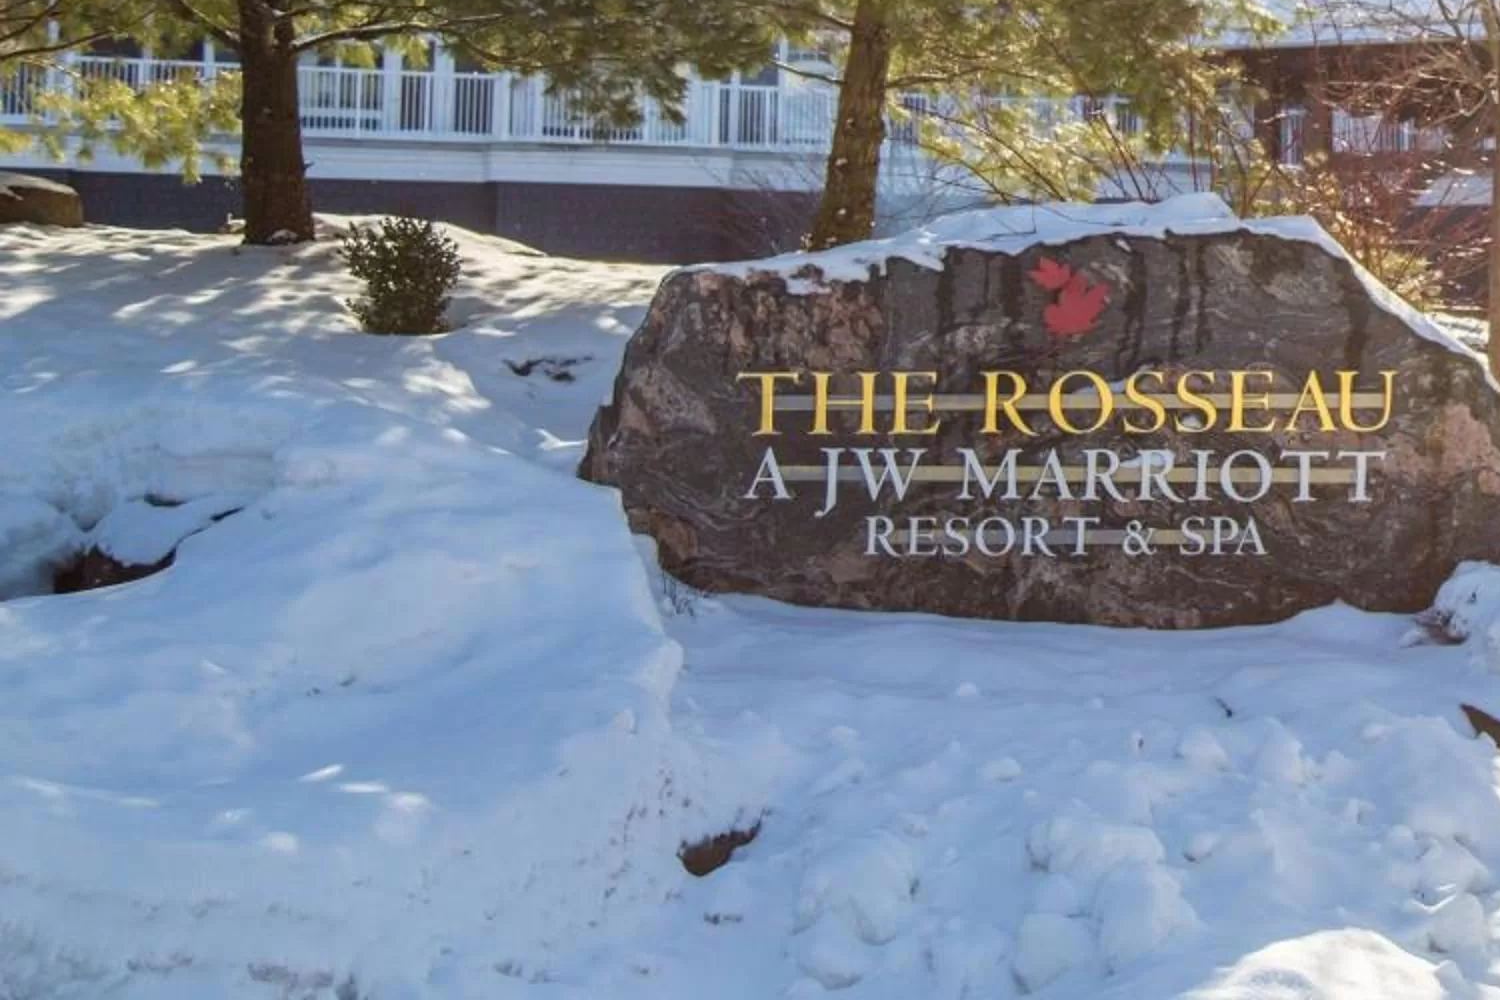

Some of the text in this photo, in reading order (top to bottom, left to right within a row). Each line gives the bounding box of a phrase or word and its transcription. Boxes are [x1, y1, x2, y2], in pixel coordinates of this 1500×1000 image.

[737, 370, 1398, 436] THE ROSSEAU
[744, 446, 1387, 517] A JW MARRIOTT
[865, 515, 1268, 557] RESORT & SPA
